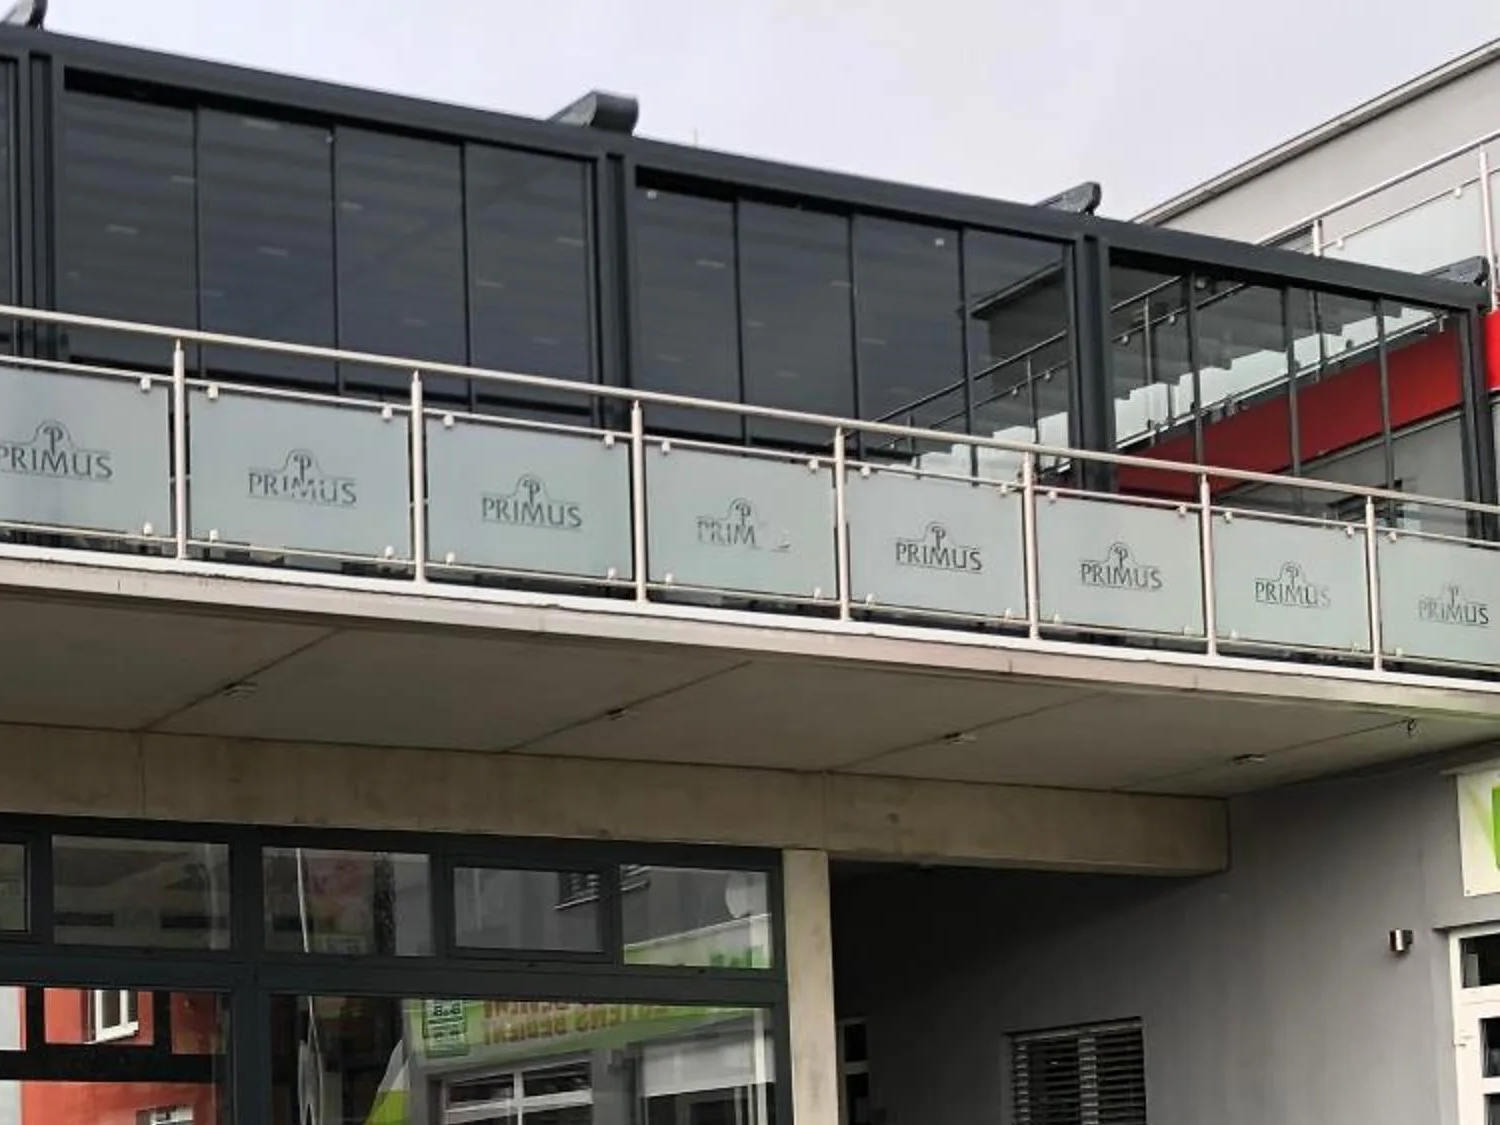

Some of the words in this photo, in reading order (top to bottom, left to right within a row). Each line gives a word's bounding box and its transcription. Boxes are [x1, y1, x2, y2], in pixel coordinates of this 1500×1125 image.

[248, 473, 357, 504] PRIMUS
[482, 497, 582, 528] PRIMUS
[896, 541, 983, 571] PRIMUS
[1081, 563, 1163, 589] PRIMUS
[1255, 581, 1332, 608] PRIMUS
